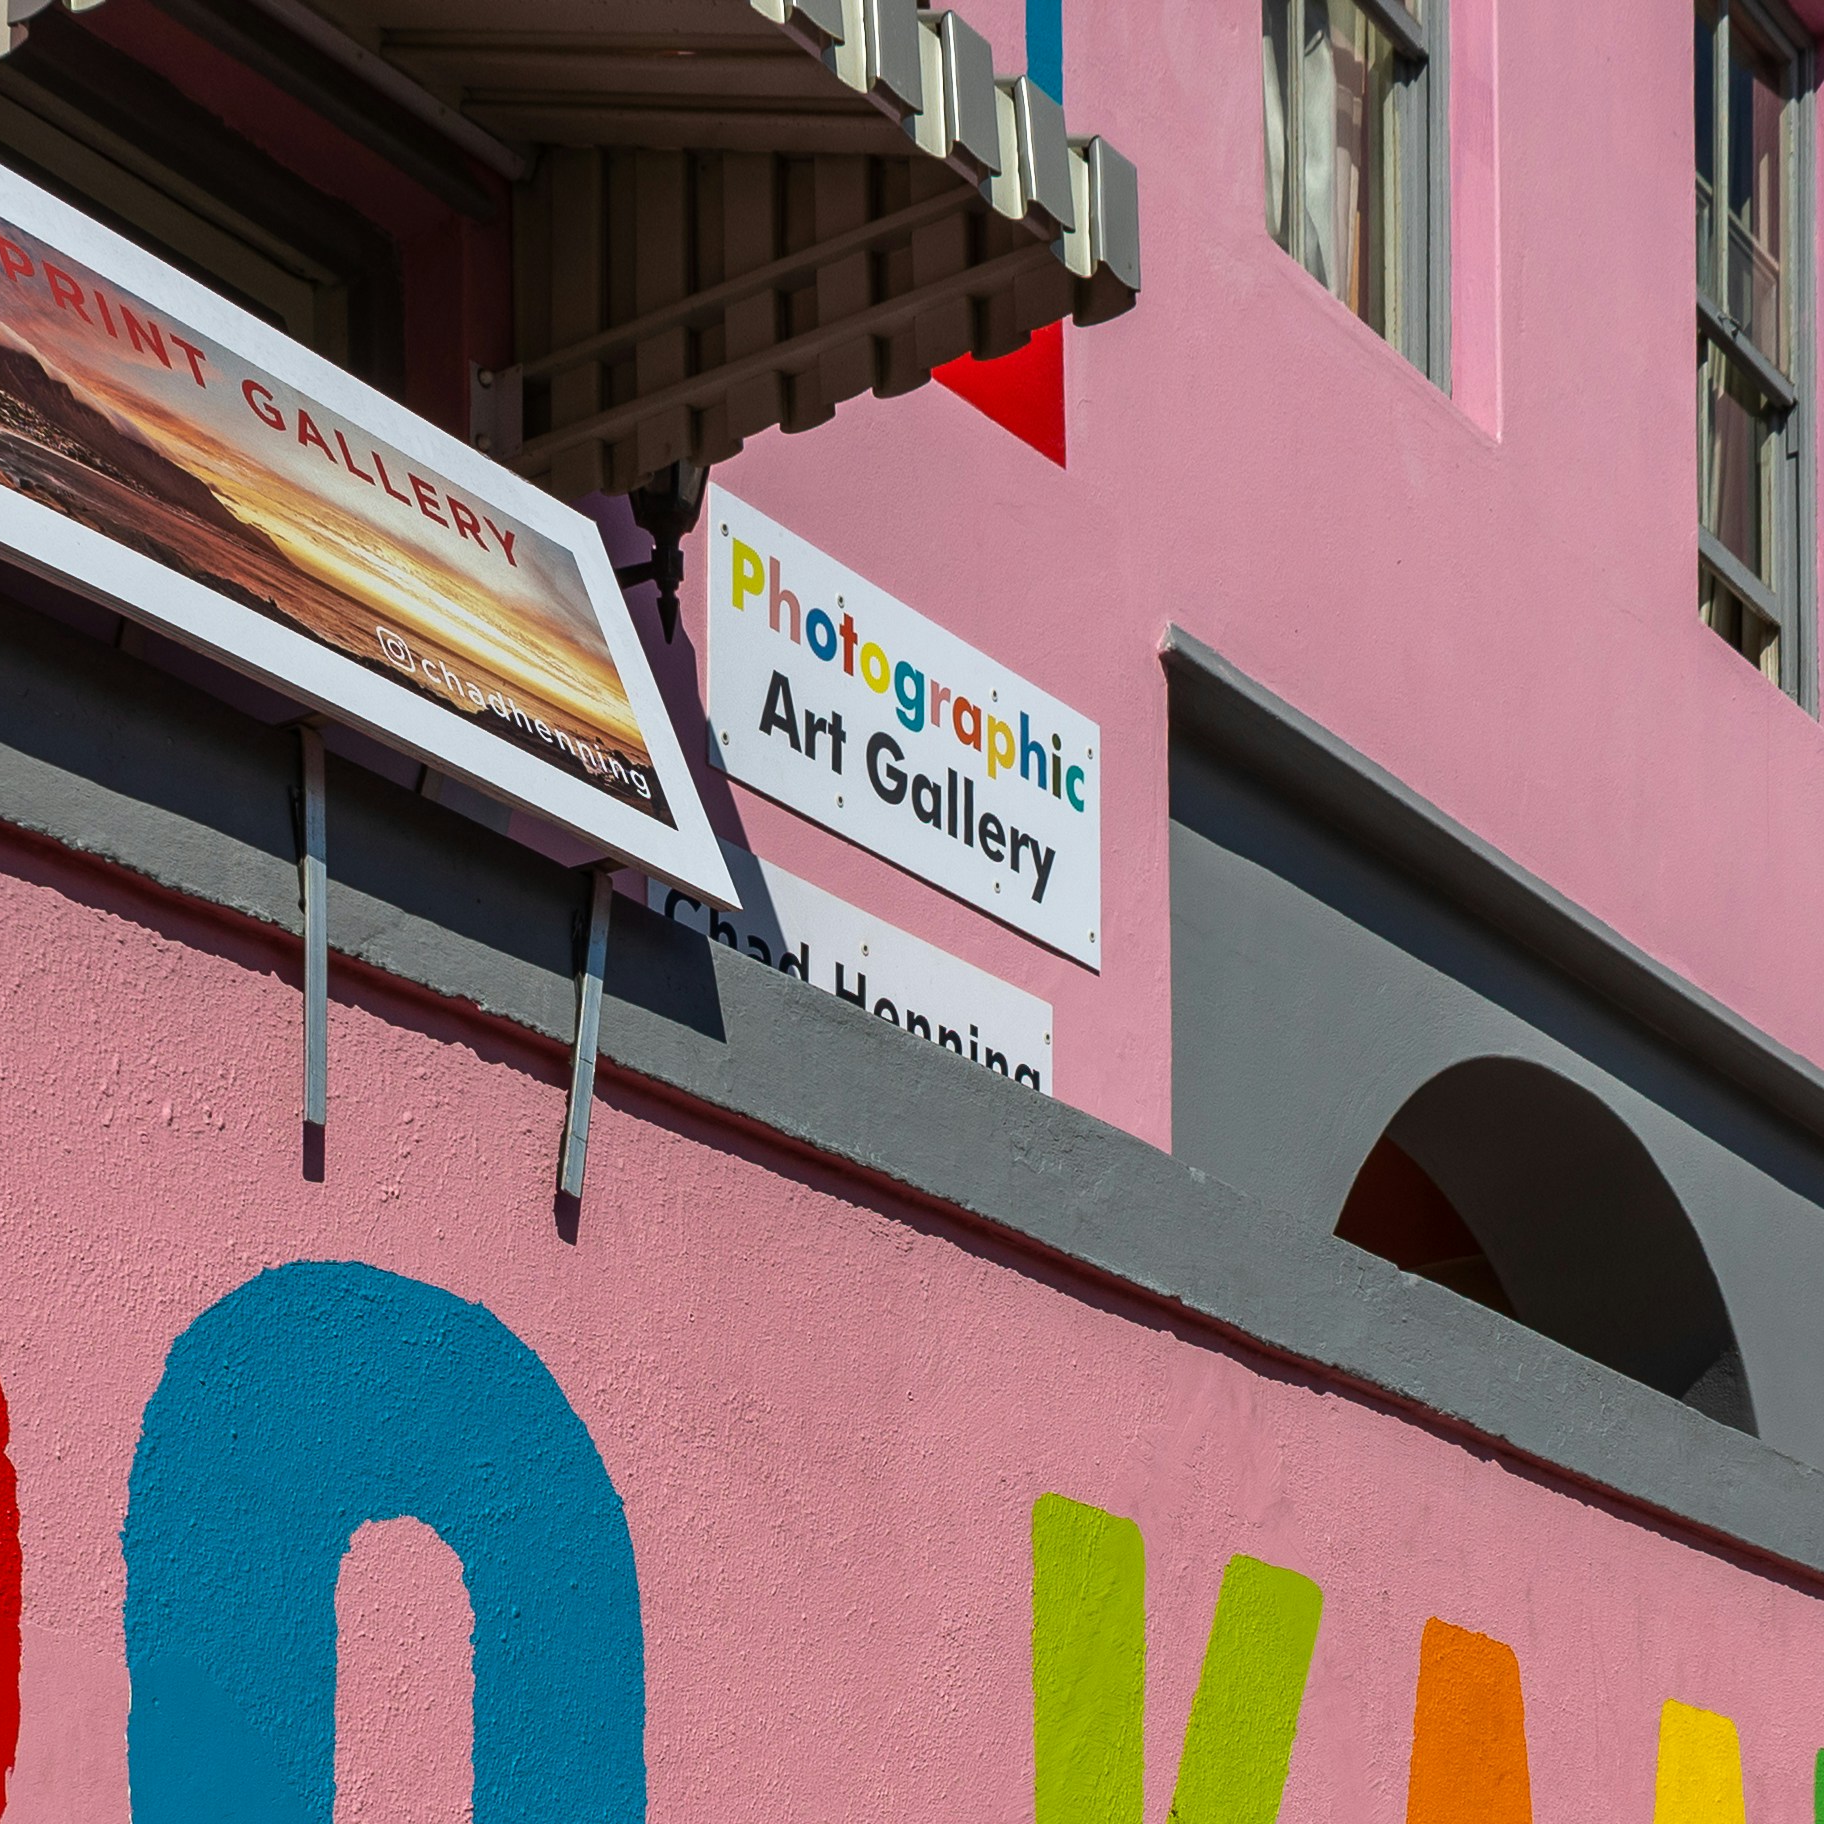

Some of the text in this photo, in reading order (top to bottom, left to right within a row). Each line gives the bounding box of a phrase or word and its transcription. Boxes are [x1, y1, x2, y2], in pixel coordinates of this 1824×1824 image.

[241, 378, 518, 567] GALLERY
[732, 537, 1085, 813] Photographic
[759, 669, 1056, 904] Art Gallery
